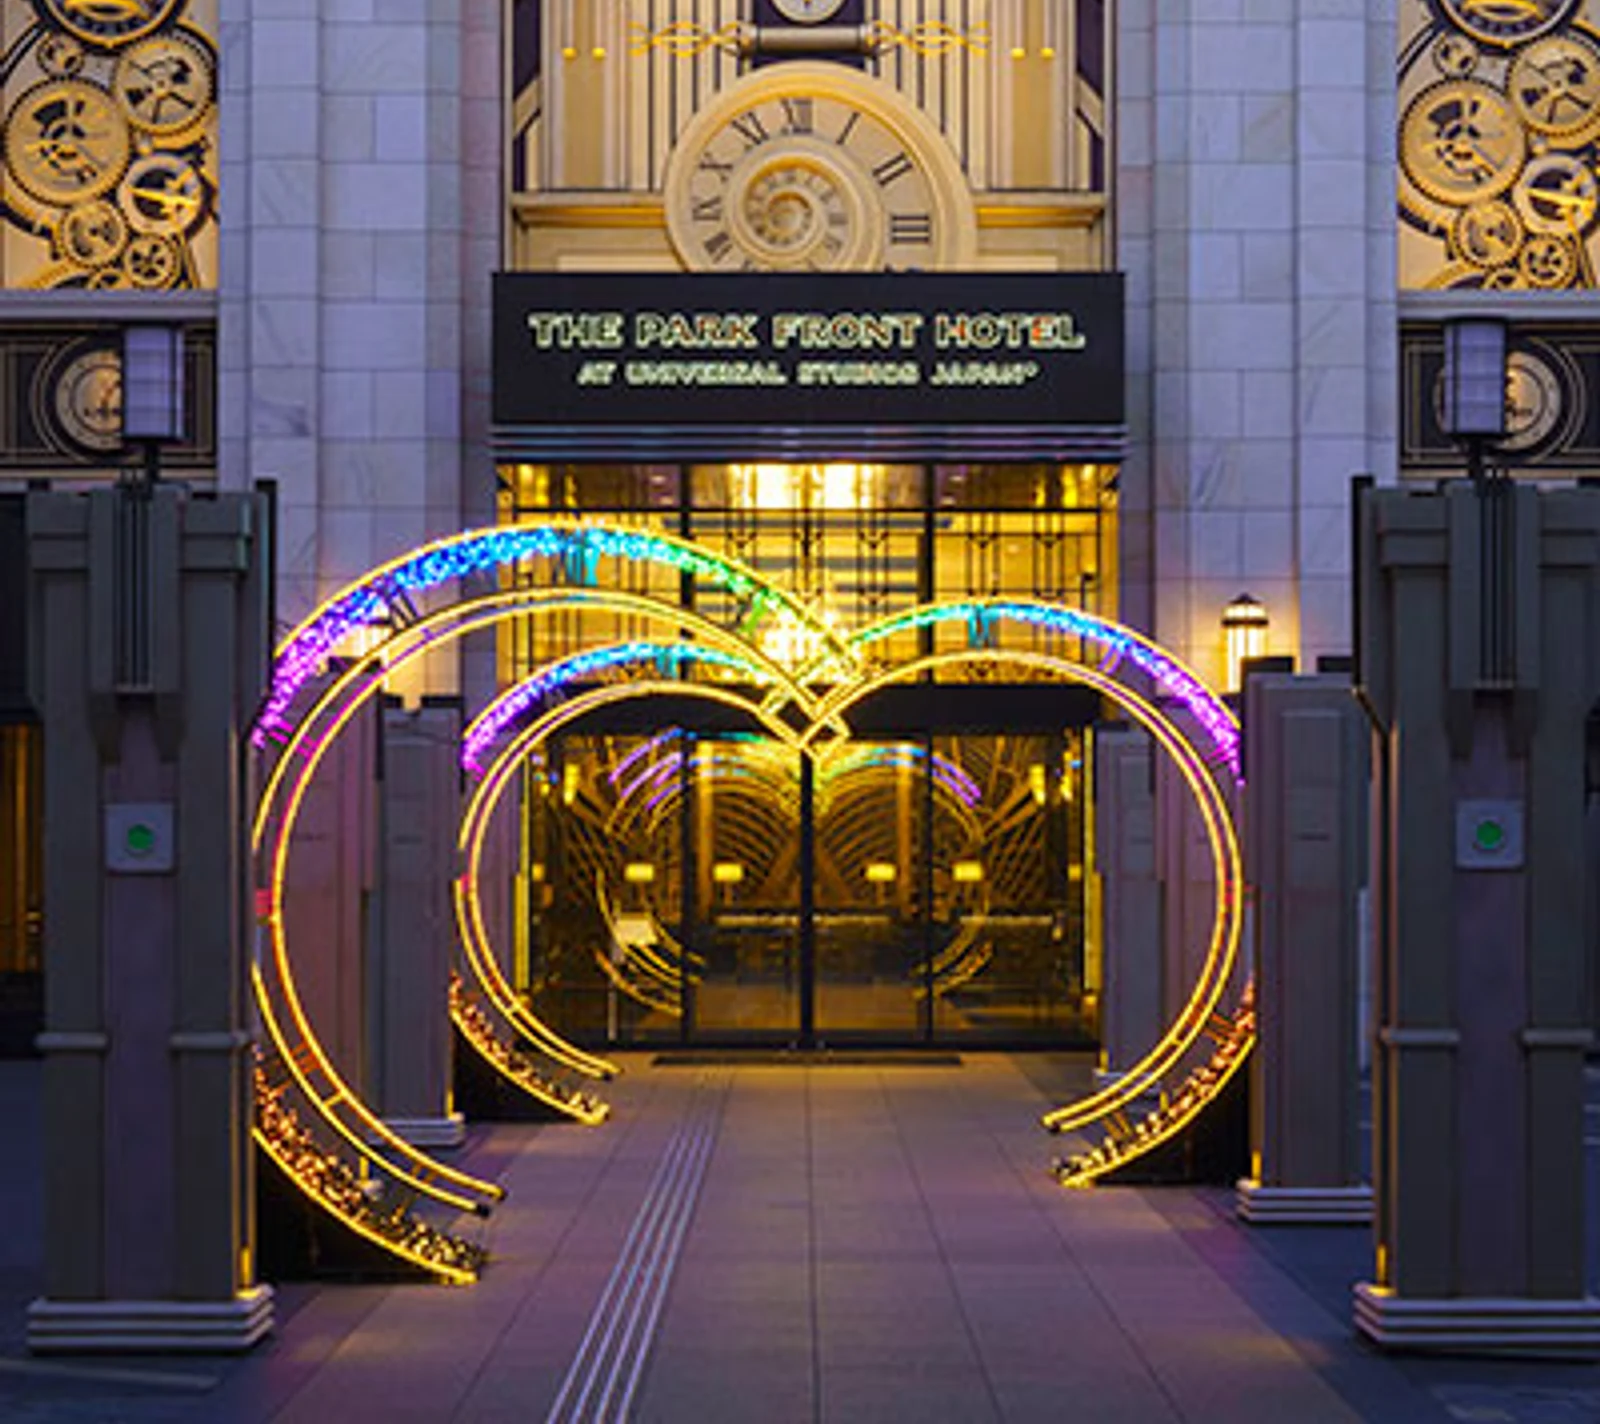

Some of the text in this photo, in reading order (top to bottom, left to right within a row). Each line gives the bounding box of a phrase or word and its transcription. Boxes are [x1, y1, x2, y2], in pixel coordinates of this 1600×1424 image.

[891, 213, 931, 245] III
[527, 312, 1087, 350] THE PARK FRONT HOTEL
[576, 360, 618, 386] AT
[623, 360, 788, 386] UNIVERSAL
[796, 360, 921, 386] STUDIOS
